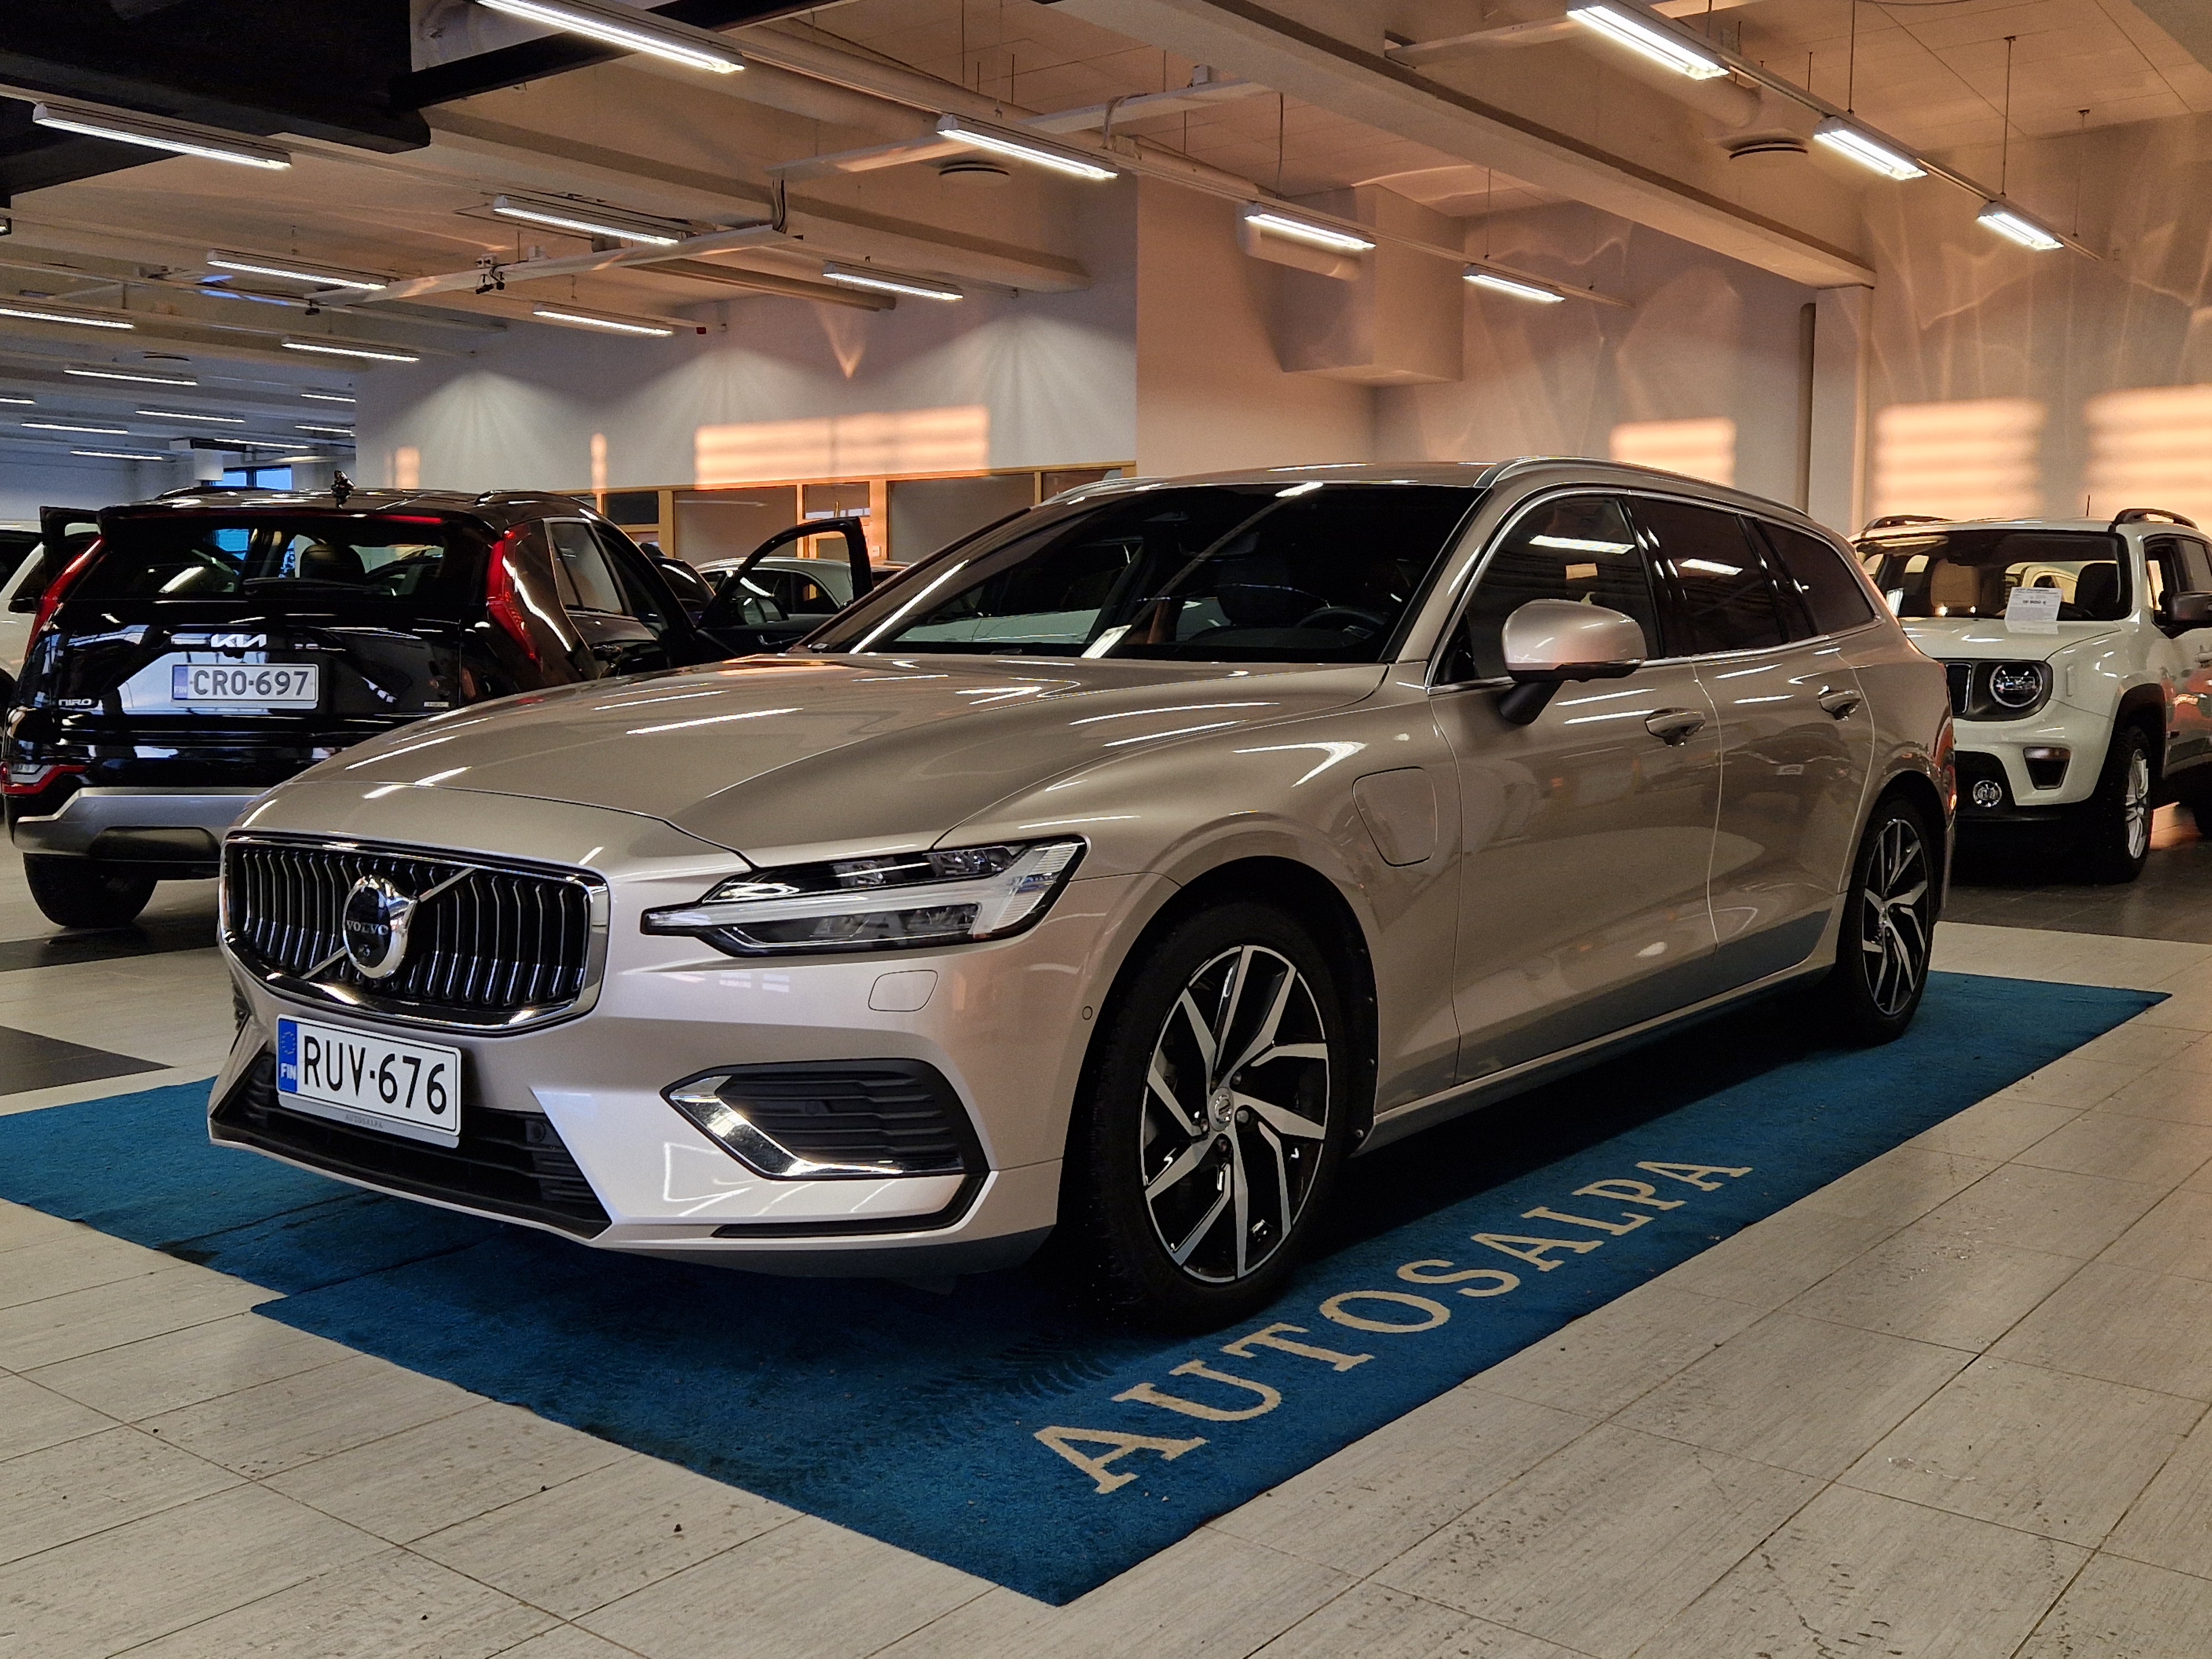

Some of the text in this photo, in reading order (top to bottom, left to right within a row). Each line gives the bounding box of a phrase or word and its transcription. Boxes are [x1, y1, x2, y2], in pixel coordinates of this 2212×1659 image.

[211, 634, 267, 648] KIA
[174, 686, 187, 694] FIN
[194, 670, 309, 696] CRO-697
[346, 920, 389, 936] VOLVO
[280, 1063, 296, 1081] FIN
[304, 1035, 447, 1115] RUV-676
[1034, 1161, 1753, 1494] AUTOSALPA
